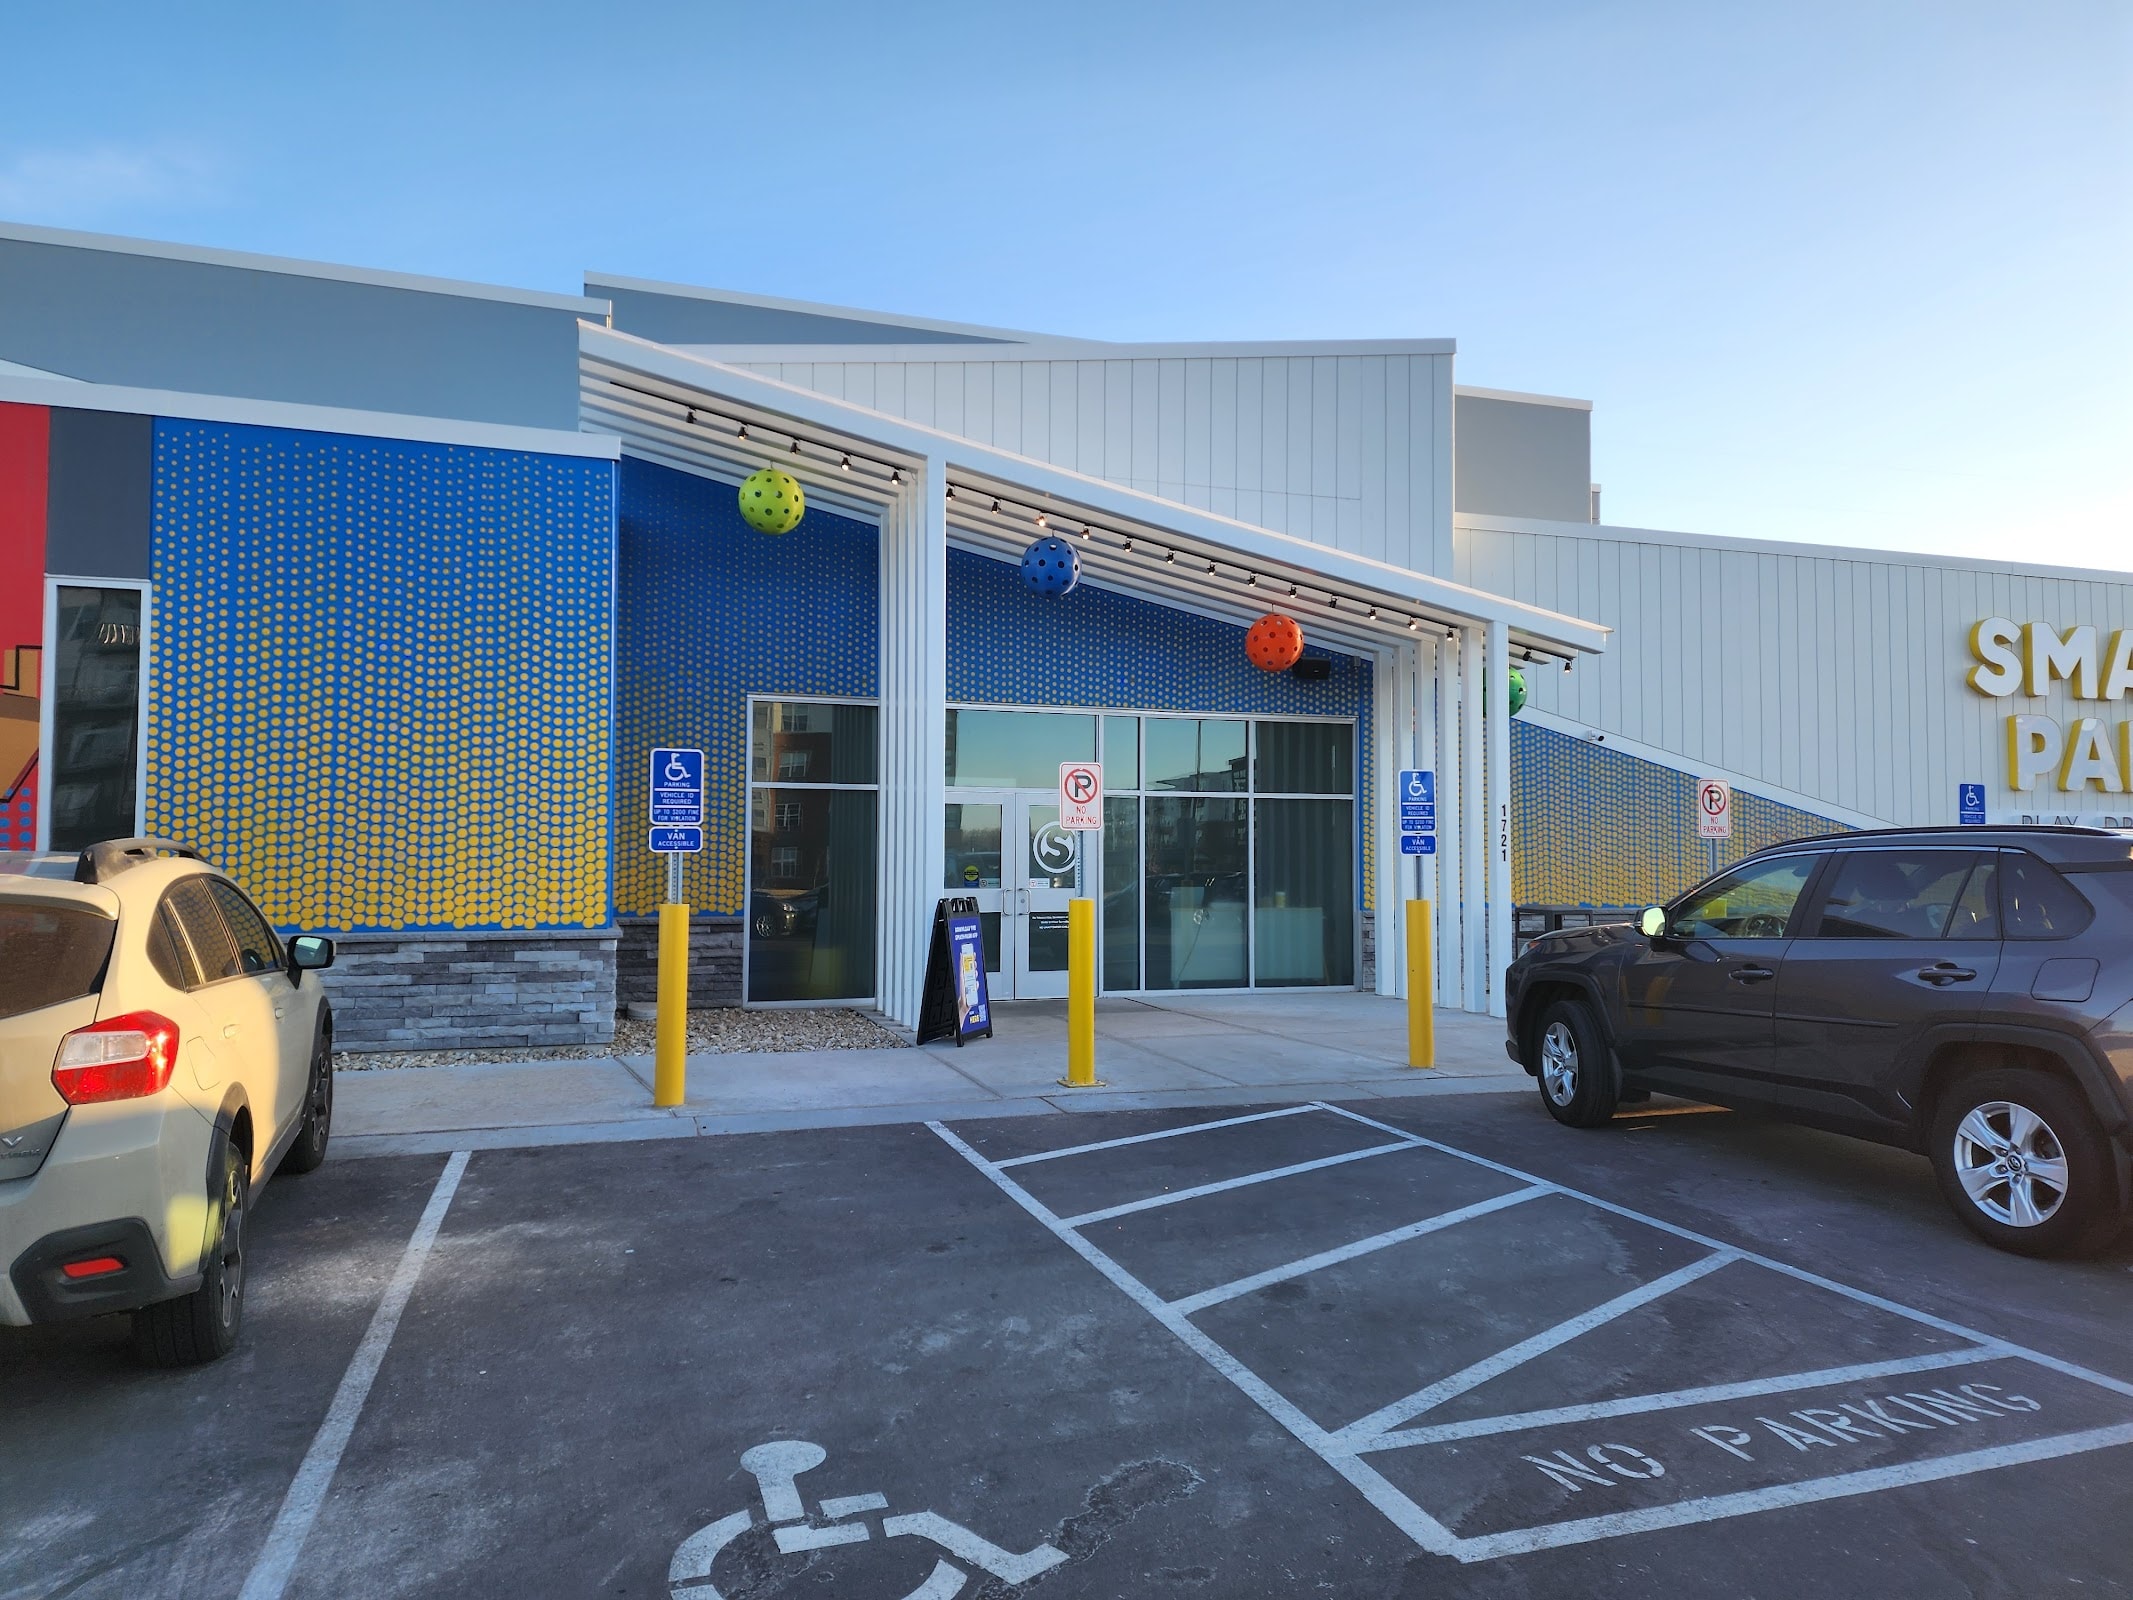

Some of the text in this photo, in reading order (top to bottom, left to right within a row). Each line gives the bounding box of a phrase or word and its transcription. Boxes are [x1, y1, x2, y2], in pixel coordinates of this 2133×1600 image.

[2007, 713, 2133, 793] PA
[1076, 805, 1087, 815] NO
[1065, 816, 1097, 825] PARKING
[1710, 816, 1718, 824] NO
[1703, 825, 1727, 834] PARKING
[667, 832, 686, 840] VAN
[1411, 838, 1425, 846] VAN
[1519, 1383, 2042, 1492] NO PARKING
